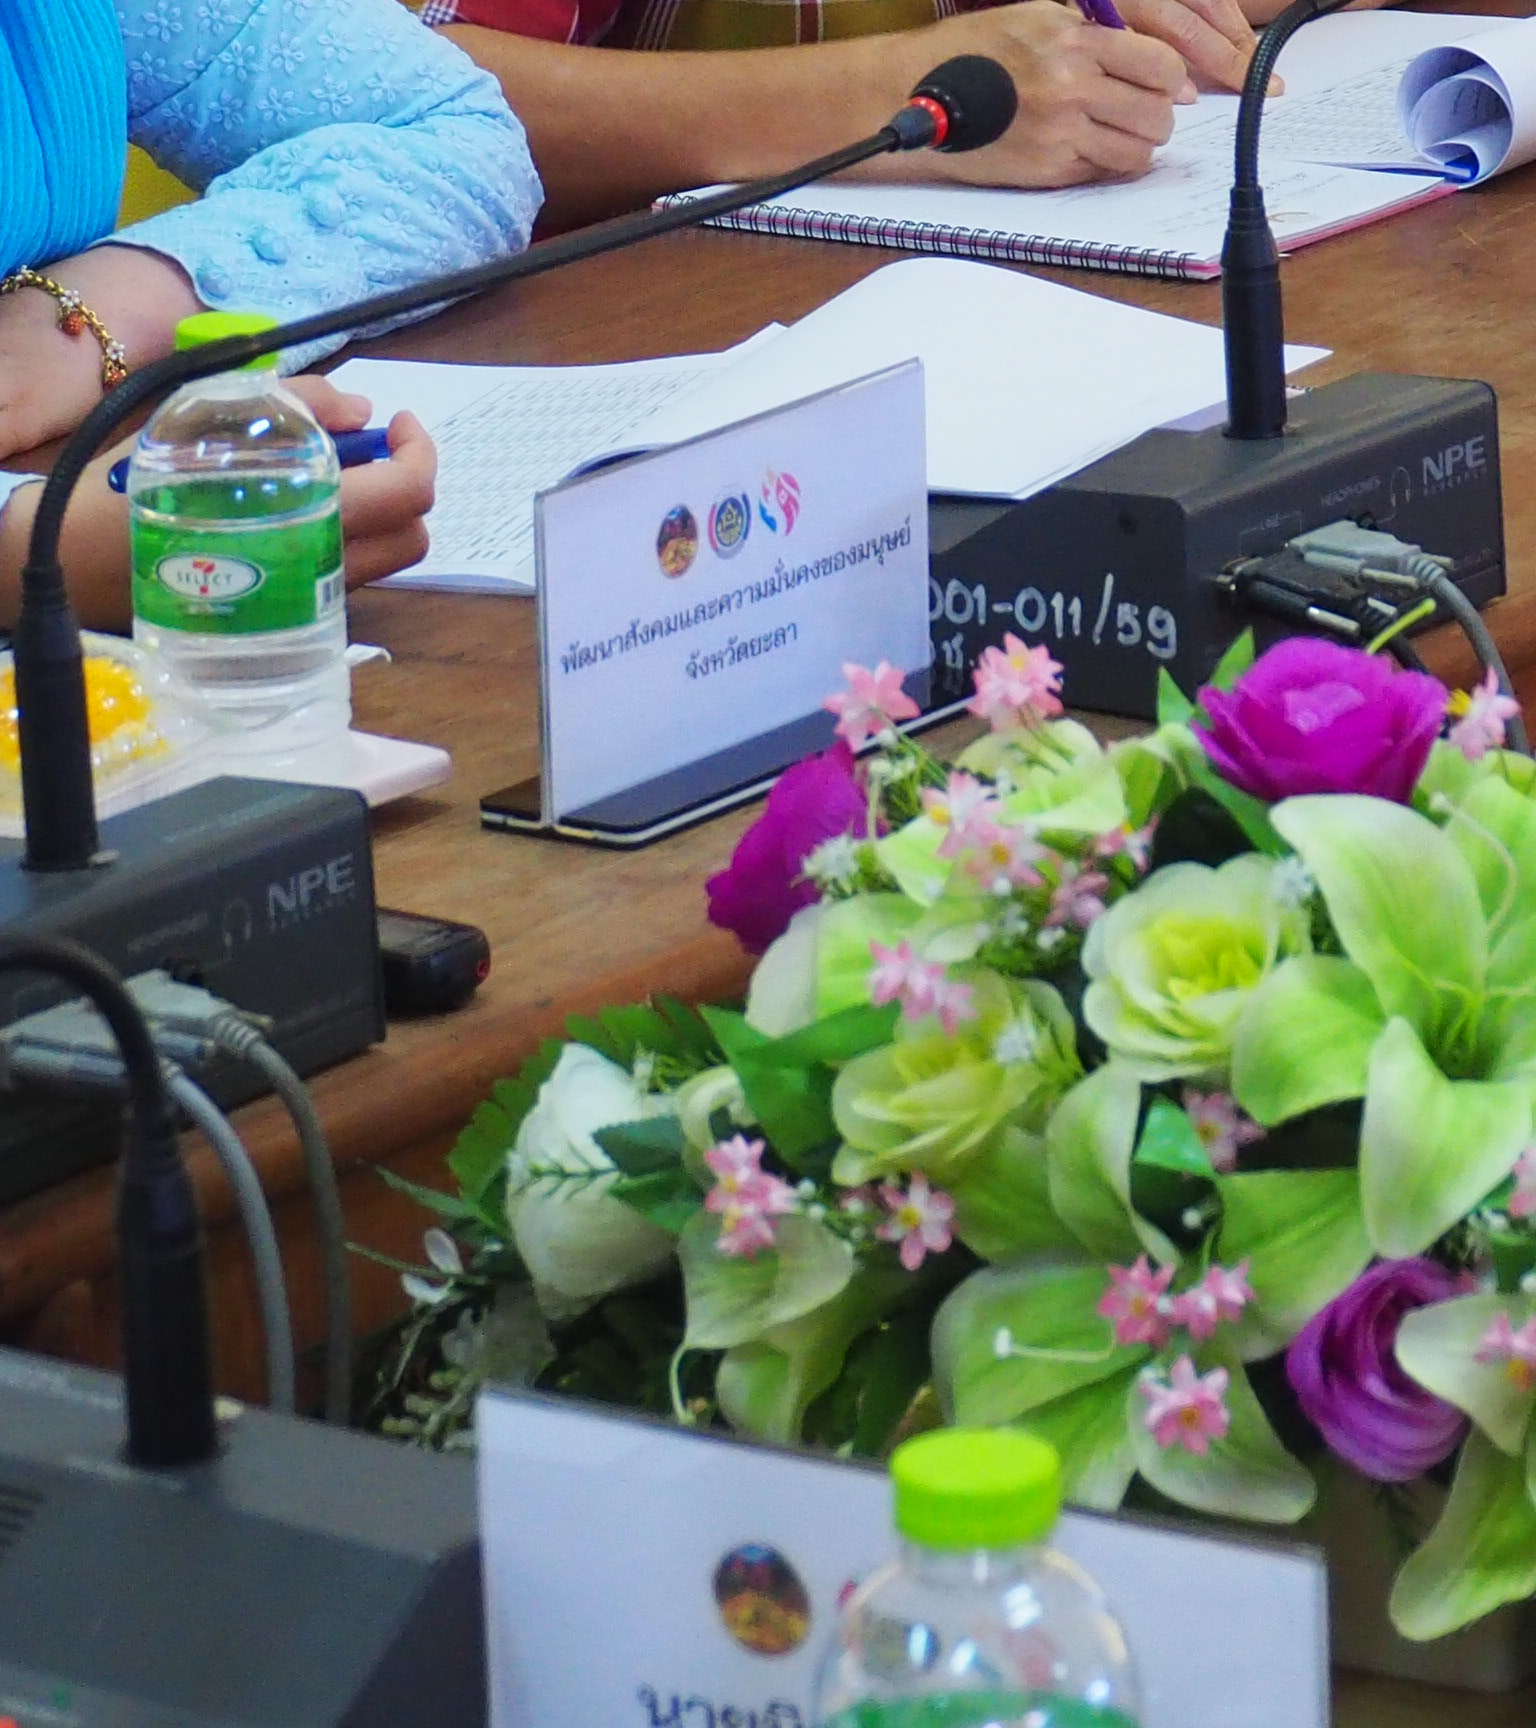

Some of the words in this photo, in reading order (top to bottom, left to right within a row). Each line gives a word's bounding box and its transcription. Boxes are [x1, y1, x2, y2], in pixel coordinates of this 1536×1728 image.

[1421, 434, 1487, 486] NPE
[176, 571, 233, 587] SELECT
[684, 622, 799, 680] จังหวัดยะลา
[266, 851, 355, 922] NPE
